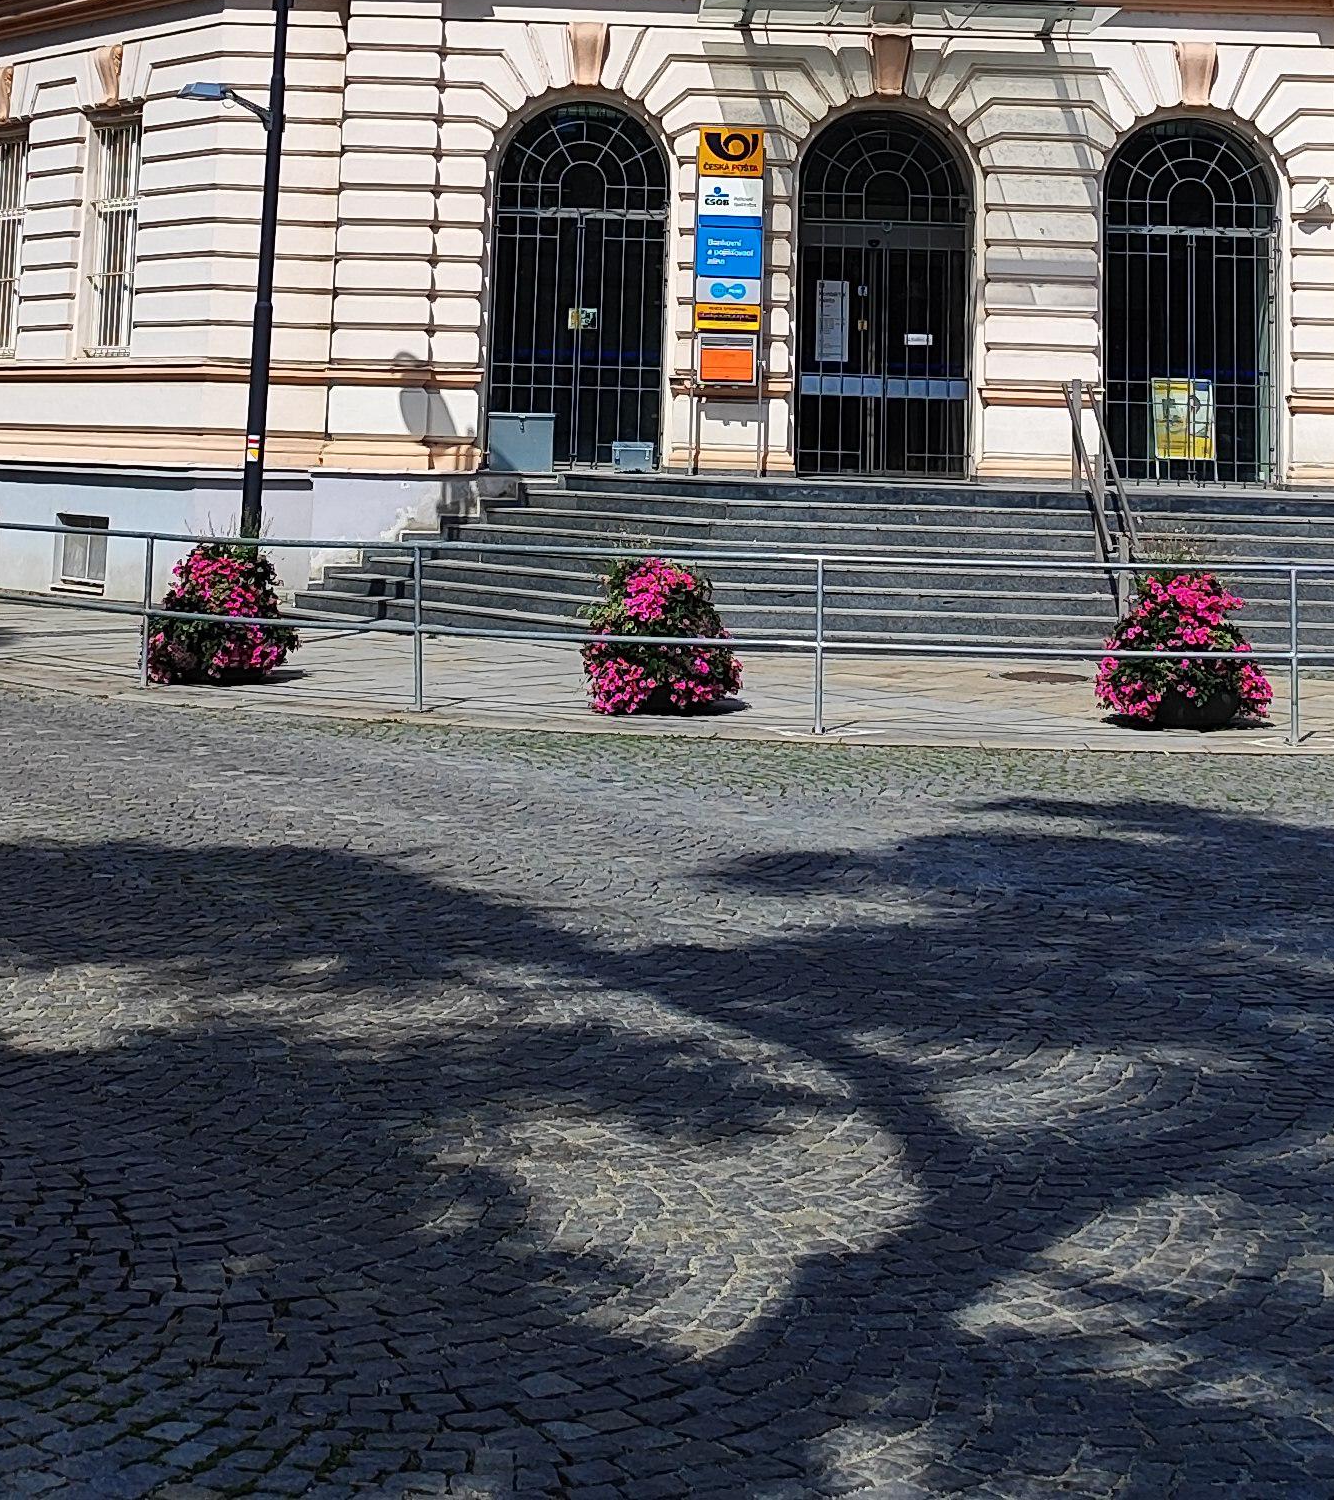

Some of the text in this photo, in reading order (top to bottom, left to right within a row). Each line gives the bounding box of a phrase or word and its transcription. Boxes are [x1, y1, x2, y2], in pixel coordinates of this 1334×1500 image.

[703, 162, 759, 172] ČESKÁ POŠTA
[704, 197, 730, 206] ČSOB
